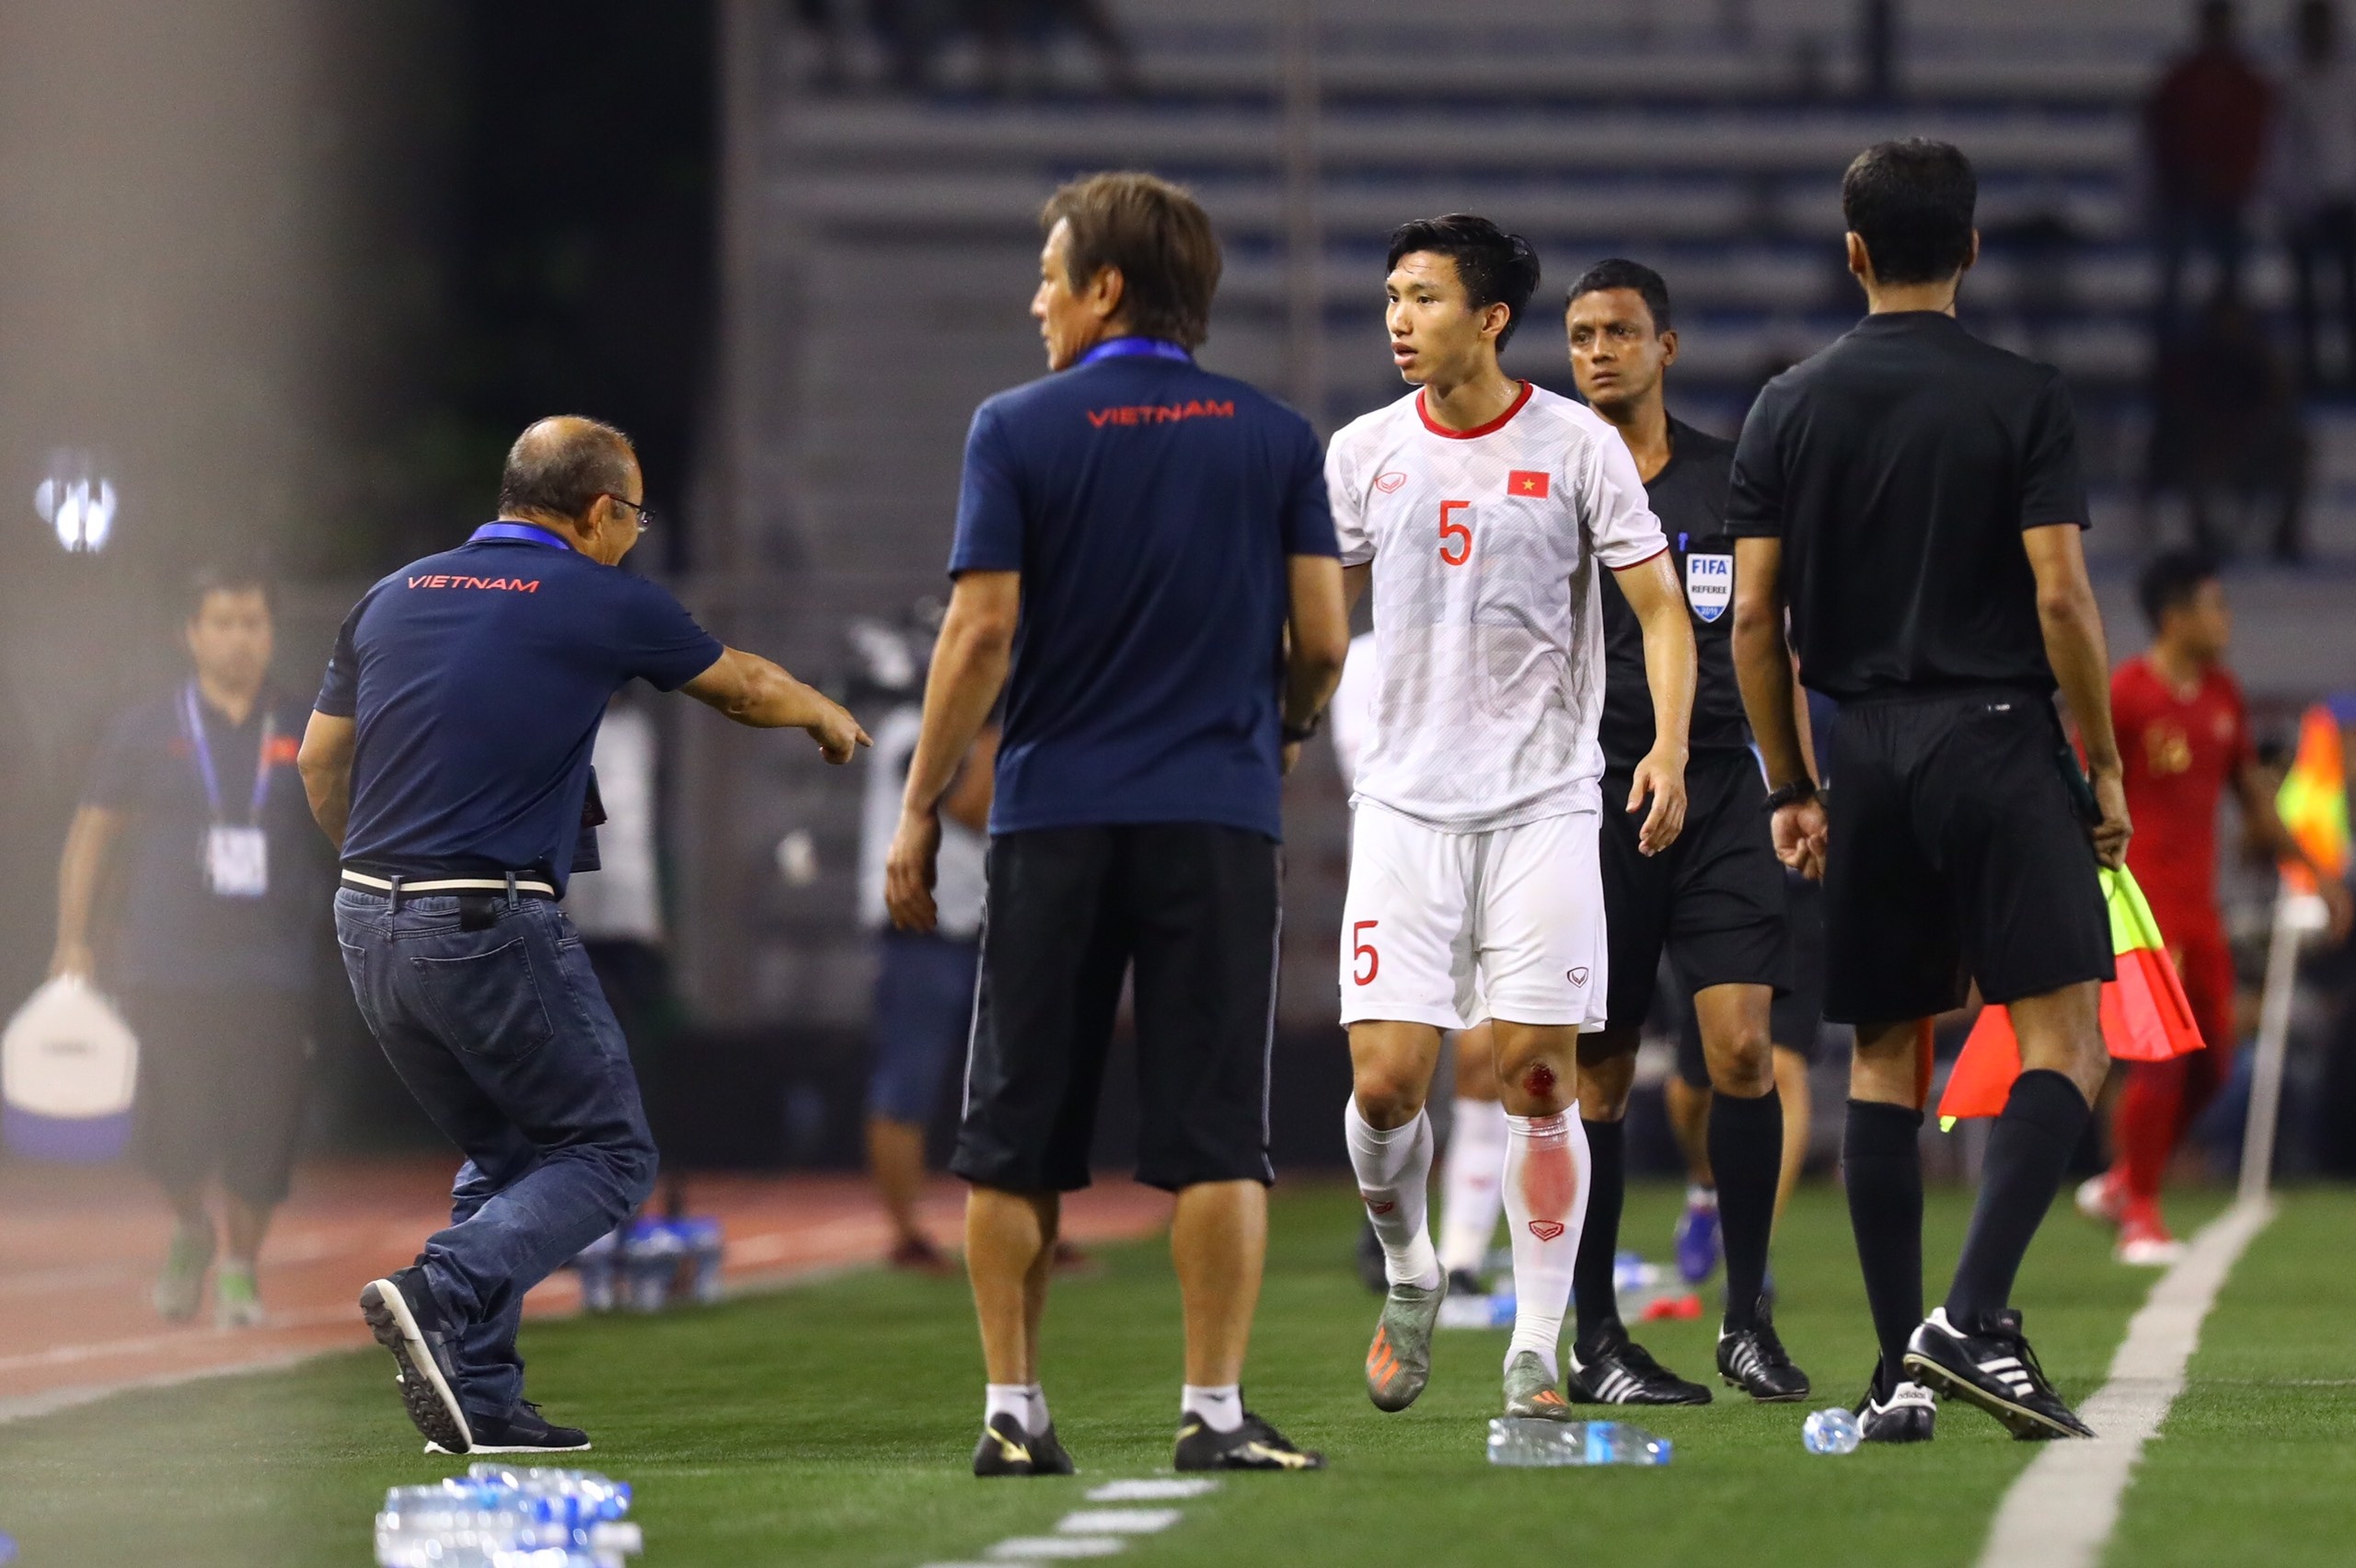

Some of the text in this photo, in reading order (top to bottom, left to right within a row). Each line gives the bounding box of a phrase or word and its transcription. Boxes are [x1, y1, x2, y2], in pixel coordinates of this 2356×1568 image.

[1088, 399, 1234, 428] VIETNAM
[1439, 500, 1472, 566] 5
[1692, 559, 1727, 575] FIFA
[408, 575, 539, 594] VIETNAM
[1692, 584, 1727, 594] REFEREE
[1354, 920, 1379, 986] 5
